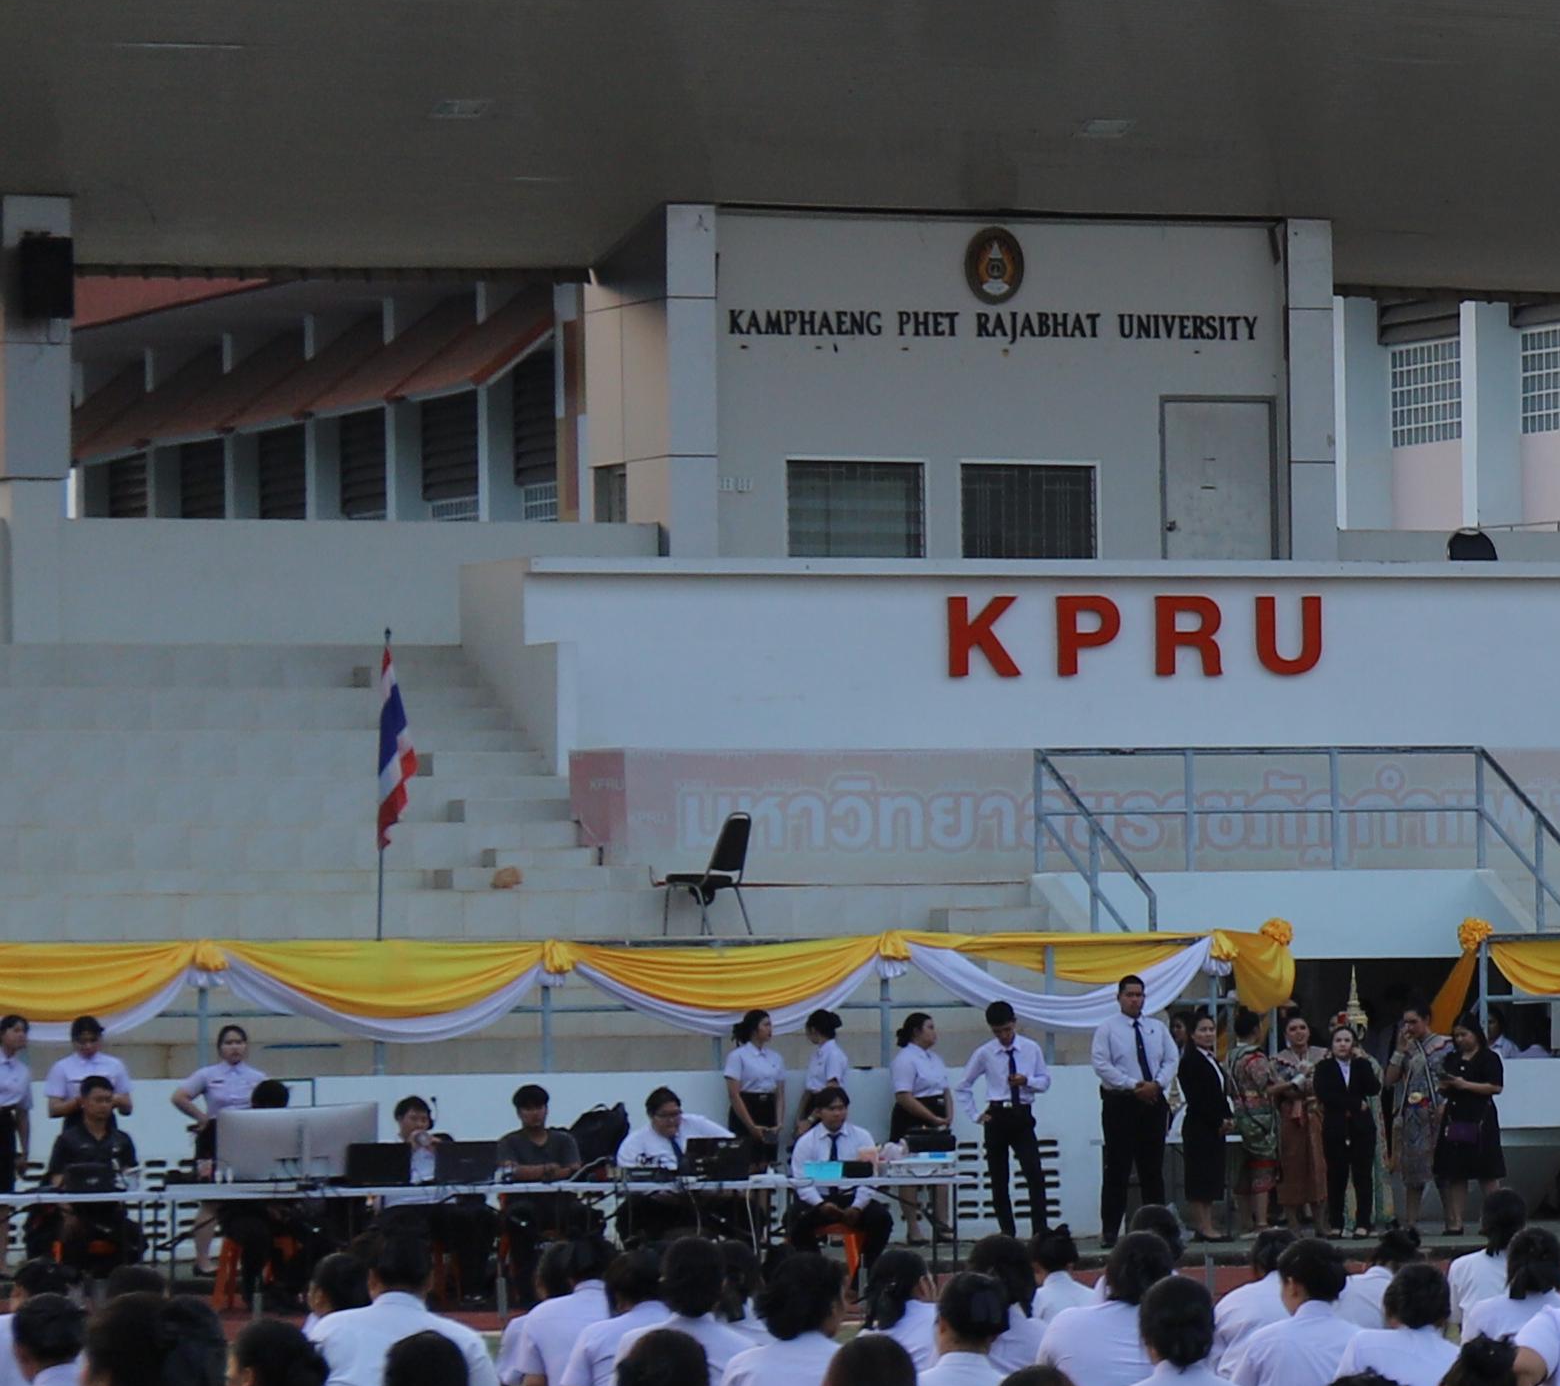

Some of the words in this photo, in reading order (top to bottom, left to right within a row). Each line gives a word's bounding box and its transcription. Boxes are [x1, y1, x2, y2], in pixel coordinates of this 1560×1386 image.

[728, 309, 882, 338] KAMPHAENG
[897, 311, 960, 338] PHET
[976, 312, 1101, 345] RAJABHAT
[1117, 315, 1258, 341] UNIVERSITY
[946, 594, 1324, 678] KPRU
